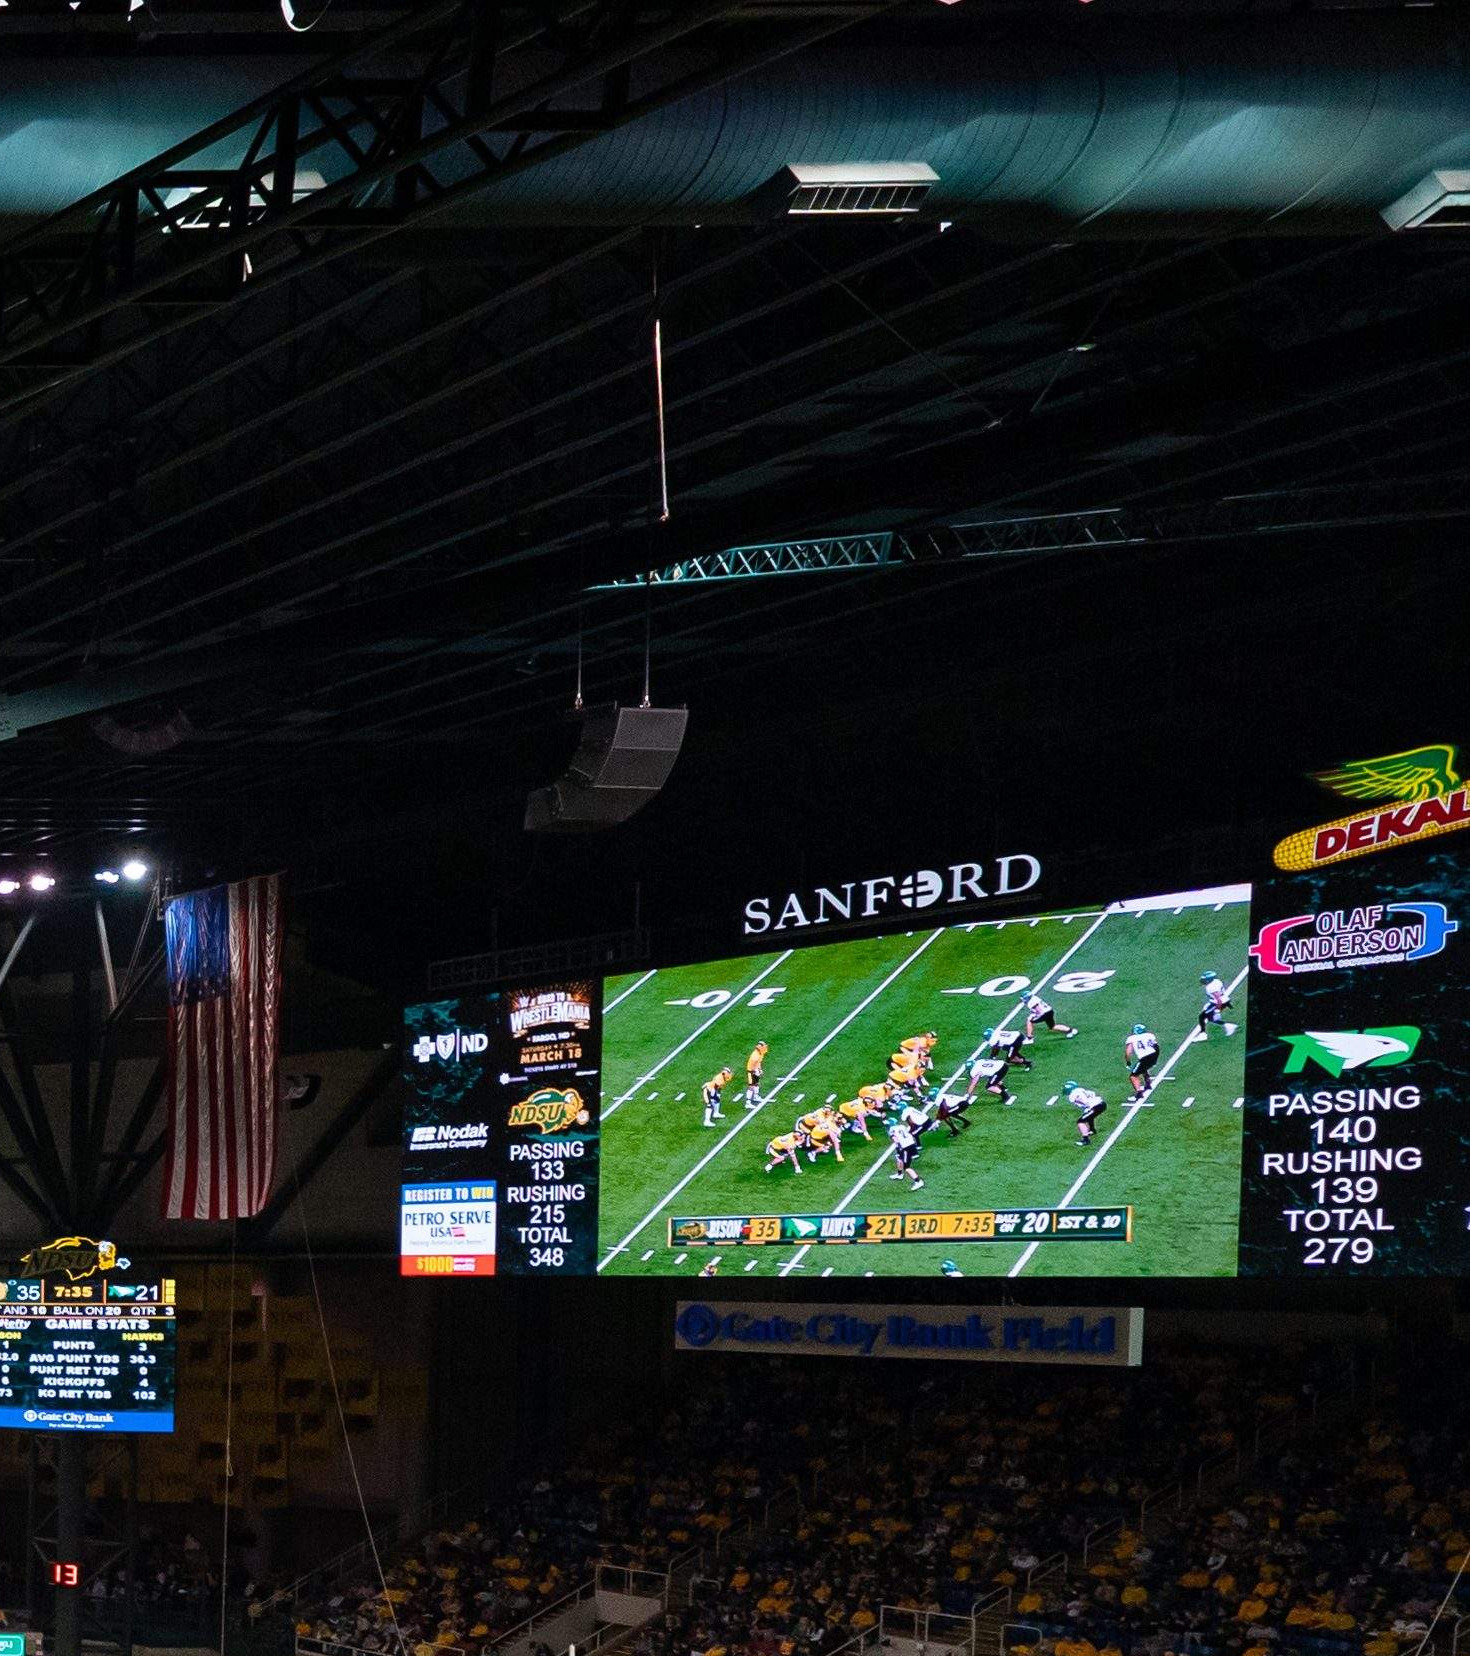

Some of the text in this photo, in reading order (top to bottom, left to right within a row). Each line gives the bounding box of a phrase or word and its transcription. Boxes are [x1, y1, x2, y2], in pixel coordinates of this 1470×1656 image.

[1313, 790, 1470, 863] DEKAL
[743, 853, 1043, 936] SANFORD
[1316, 905, 1384, 935] OLAF
[1281, 925, 1422, 963] ANDERSON
[461, 1034, 489, 1053] ND
[520, 1047, 583, 1065] MARCH 18
[1268, 1085, 1421, 1117] PASSING
[509, 1102, 564, 1126] NDSU
[437, 1122, 489, 1141] Nodak
[1310, 1116, 1377, 1144] 140
[509, 1140, 585, 1161] PASSING
[1262, 1147, 1422, 1175] RUSHING
[530, 1160, 565, 1181] 133
[507, 1184, 586, 1203] RUSHING
[1311, 1176, 1378, 1204] 139
[404, 1210, 492, 1226] PETRO SERVE
[529, 1204, 565, 1224] 215
[1022, 1212, 1122, 1234] 20 1ST 10
[1283, 1208, 1395, 1232] TOTAL
[430, 1226, 452, 1238] USA
[517, 1226, 573, 1244] TOTAL
[705, 1215, 992, 1239] BISON 35 HAWKS 21 3RD 7:35
[528, 1247, 564, 1267] 348
[1303, 1237, 1374, 1264] 279
[16, 1284, 159, 1301] 35 7:35 21
[130, 1306, 157, 1316] QTR
[45, 1318, 150, 1330] GAME STATS
[43, 1377, 106, 1387] KICKOFFS
[54, 1564, 78, 1586] 13
